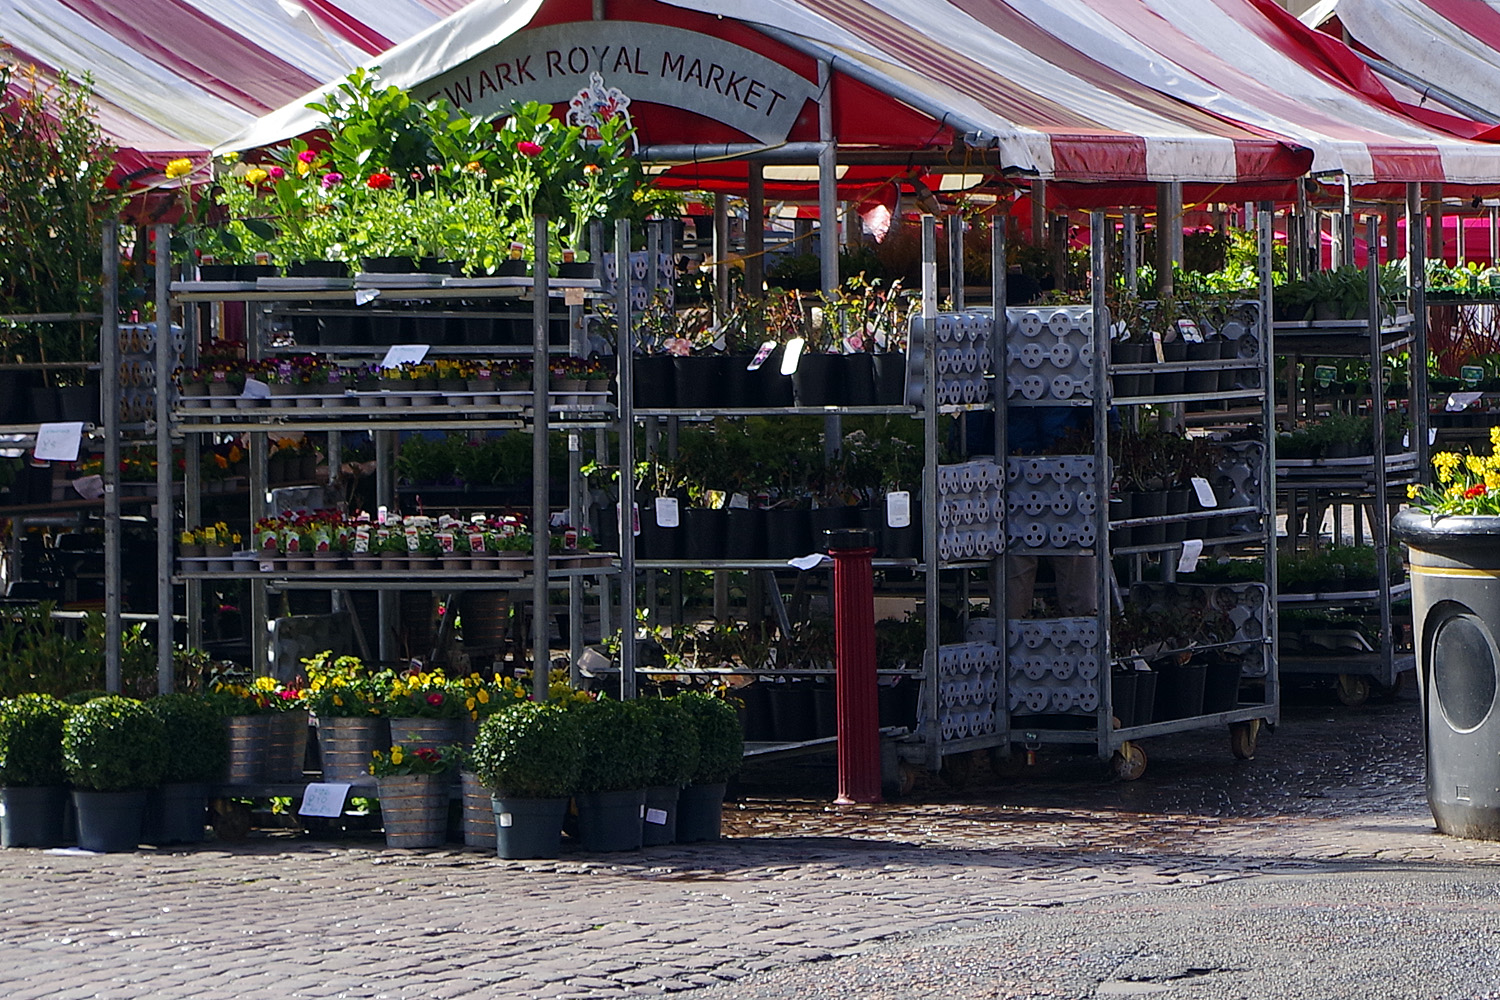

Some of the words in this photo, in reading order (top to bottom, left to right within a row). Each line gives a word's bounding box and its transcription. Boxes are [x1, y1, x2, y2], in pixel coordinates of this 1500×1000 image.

[421, 55, 536, 108] WARK
[546, 45, 649, 78] ROYAL
[661, 51, 787, 116] MARKET
